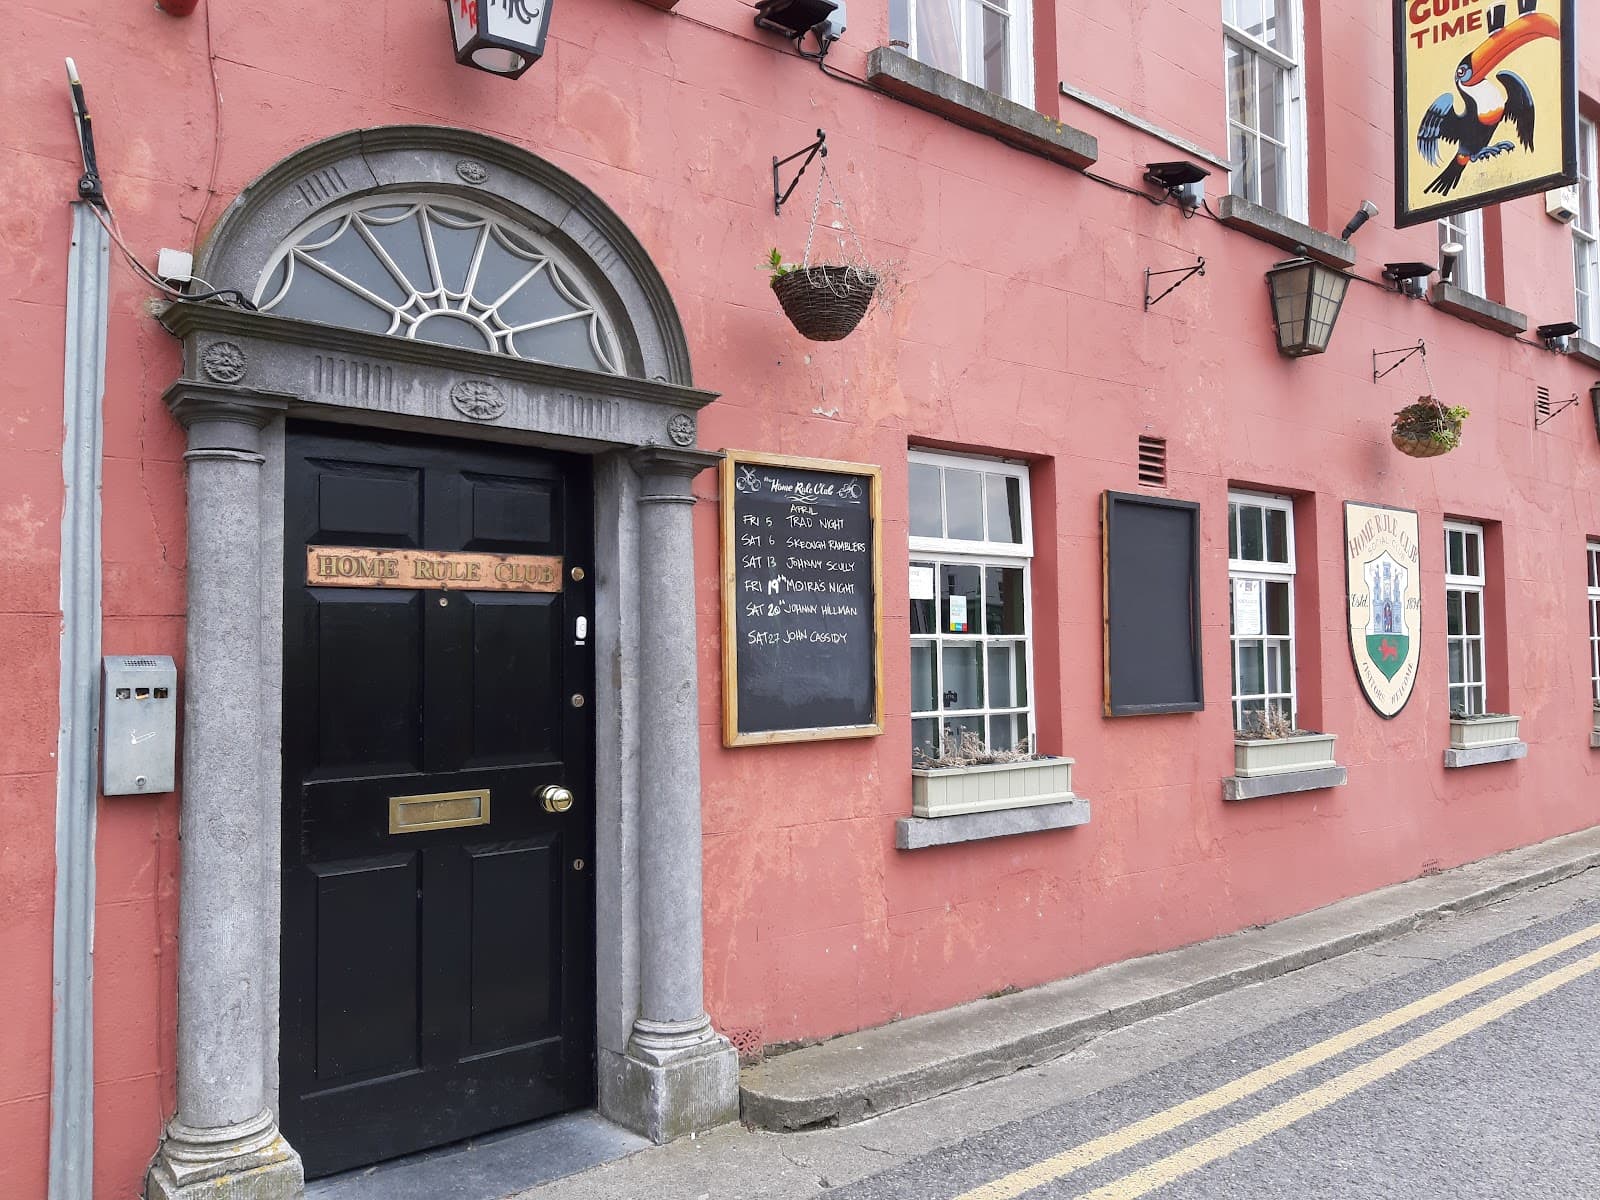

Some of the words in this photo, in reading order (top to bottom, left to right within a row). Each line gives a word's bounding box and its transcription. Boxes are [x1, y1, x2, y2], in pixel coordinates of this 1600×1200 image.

[1410, 9, 1482, 49] TIME
[770, 479, 793, 493] Home
[794, 482, 813, 495] Rule
[813, 482, 835, 496] Club
[790, 504, 818, 516] APRIL
[743, 514, 760, 527] FRI
[765, 516, 773, 527] 5
[786, 514, 813, 529] TRAD
[819, 517, 844, 531] NIGHT
[741, 533, 760, 547] SAT
[768, 535, 776, 546] 6
[828, 539, 866, 553] RAMBLERS
[1349, 518, 1375, 559] HOME
[1374, 513, 1398, 538] RULE
[1399, 530, 1418, 564] CLUB
[317, 555, 399, 579] HOME
[413, 558, 481, 582] RULE
[495, 562, 554, 584] CLUB
[742, 554, 762, 569] SAT
[767, 556, 777, 568] 13
[786, 556, 822, 570] JOHNNY
[825, 560, 856, 573] SCULLY
[744, 579, 763, 593] FRI
[829, 581, 855, 595] NIGHT
[746, 601, 765, 617] SAT
[783, 603, 818, 616] JOHNNY
[821, 603, 858, 618] HILLMAN
[782, 629, 808, 644] JOHN
[809, 630, 848, 644] CASSIDY
[1362, 662, 1386, 703] VISITORS
[1391, 661, 1414, 705] WELCOME
